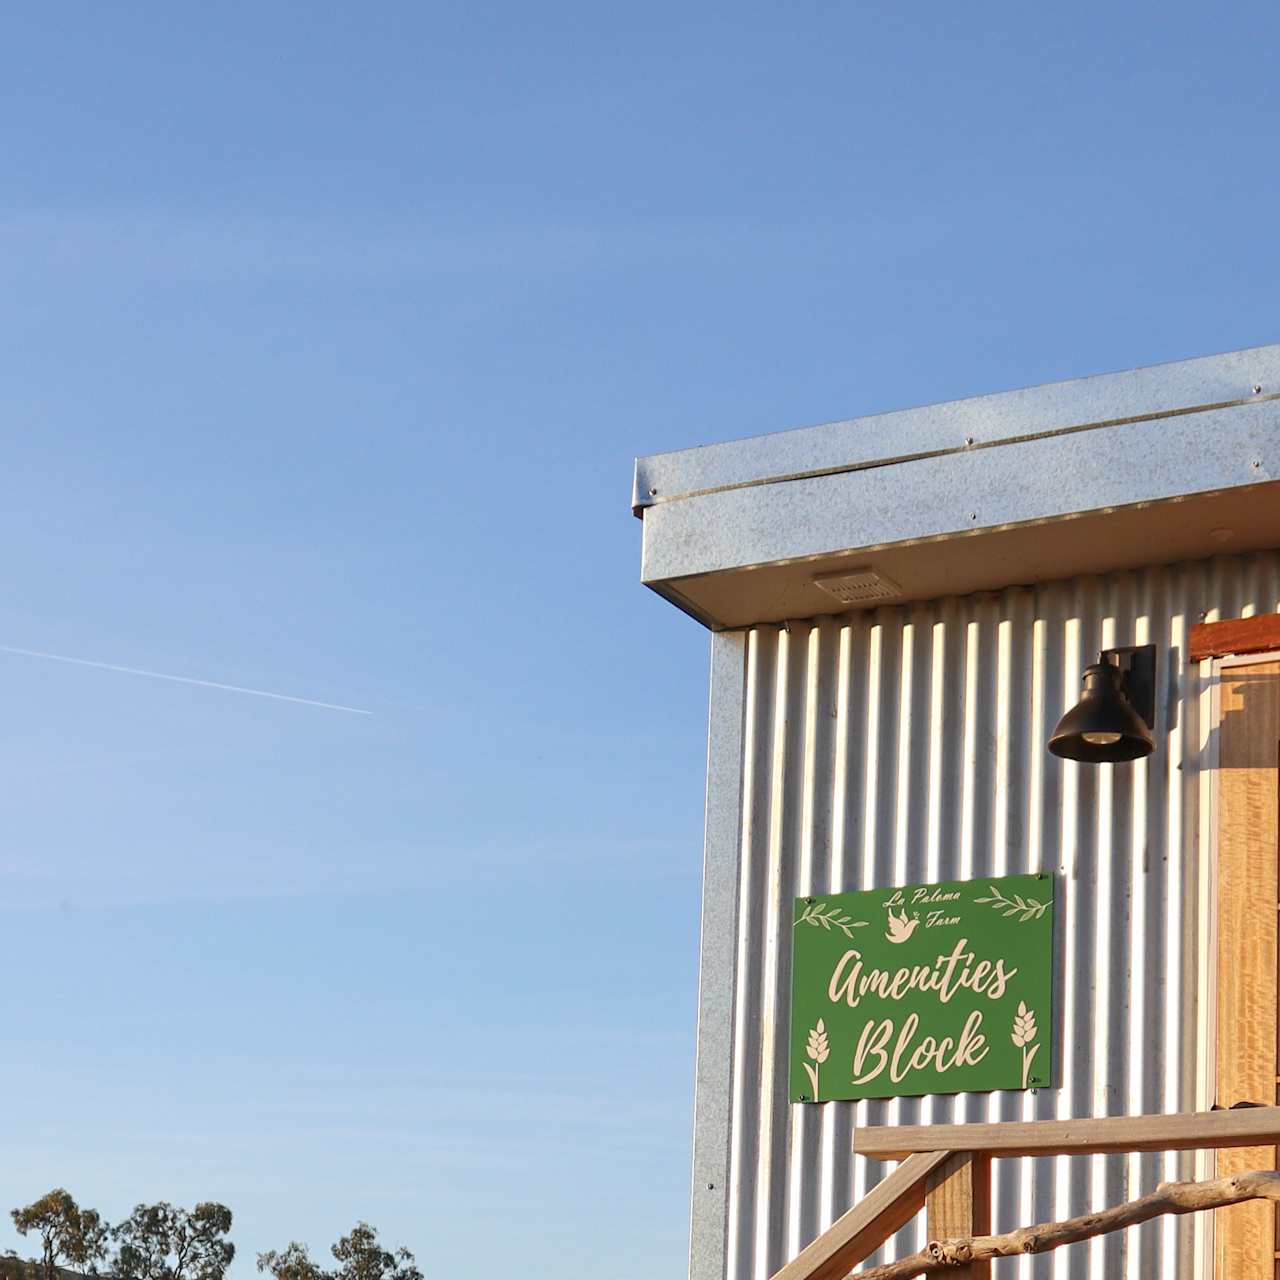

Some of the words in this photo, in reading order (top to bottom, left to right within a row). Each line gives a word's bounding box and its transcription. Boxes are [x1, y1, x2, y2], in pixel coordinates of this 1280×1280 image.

[882, 890, 905, 907] La
[911, 887, 961, 904] Paloma
[925, 909, 961, 928] Farm
[828, 938, 1018, 1007] Amenities
[851, 1010, 990, 1085] Block
